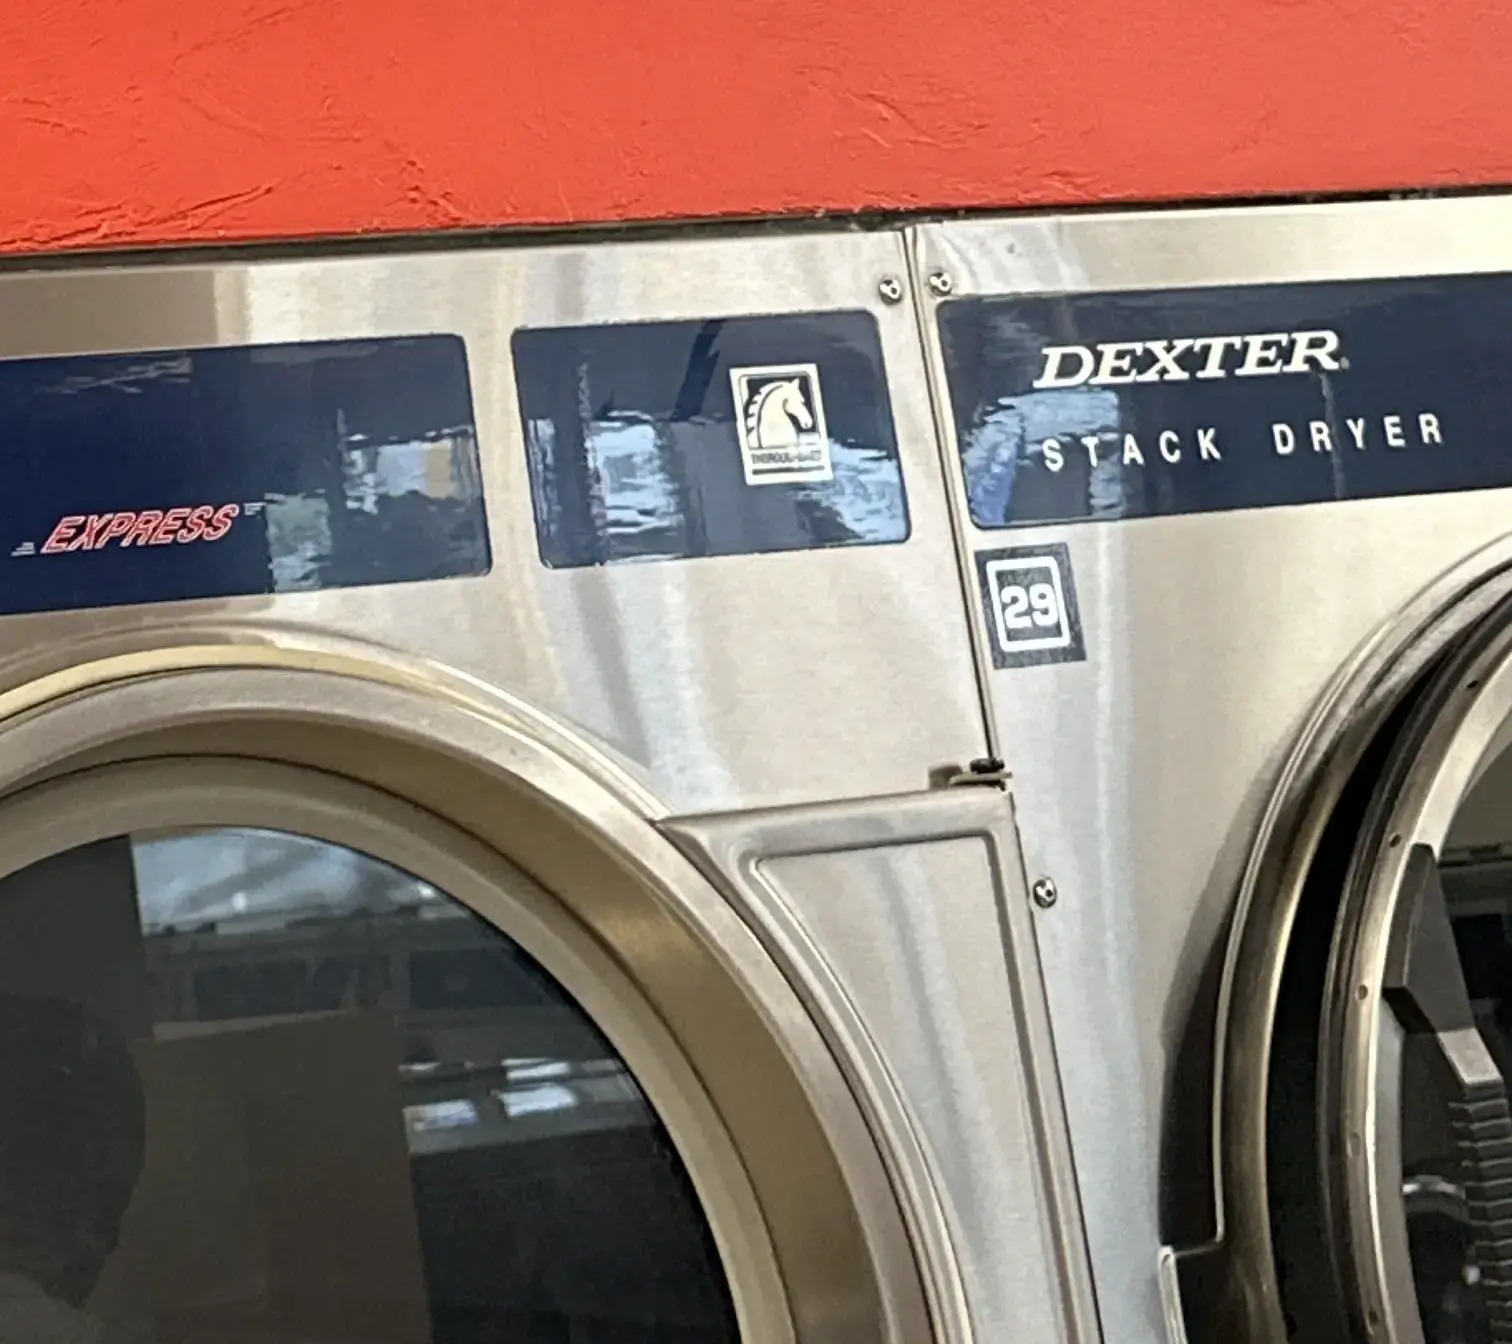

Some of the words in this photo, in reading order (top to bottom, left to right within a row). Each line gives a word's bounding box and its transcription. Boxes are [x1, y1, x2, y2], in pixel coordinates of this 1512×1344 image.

[1033, 330, 1342, 389] DEXTER
[1041, 427, 1222, 472] STACK
[1272, 412, 1444, 455] DRYER
[39, 503, 240, 554] EXPRESS
[1000, 582, 1059, 629] 29
